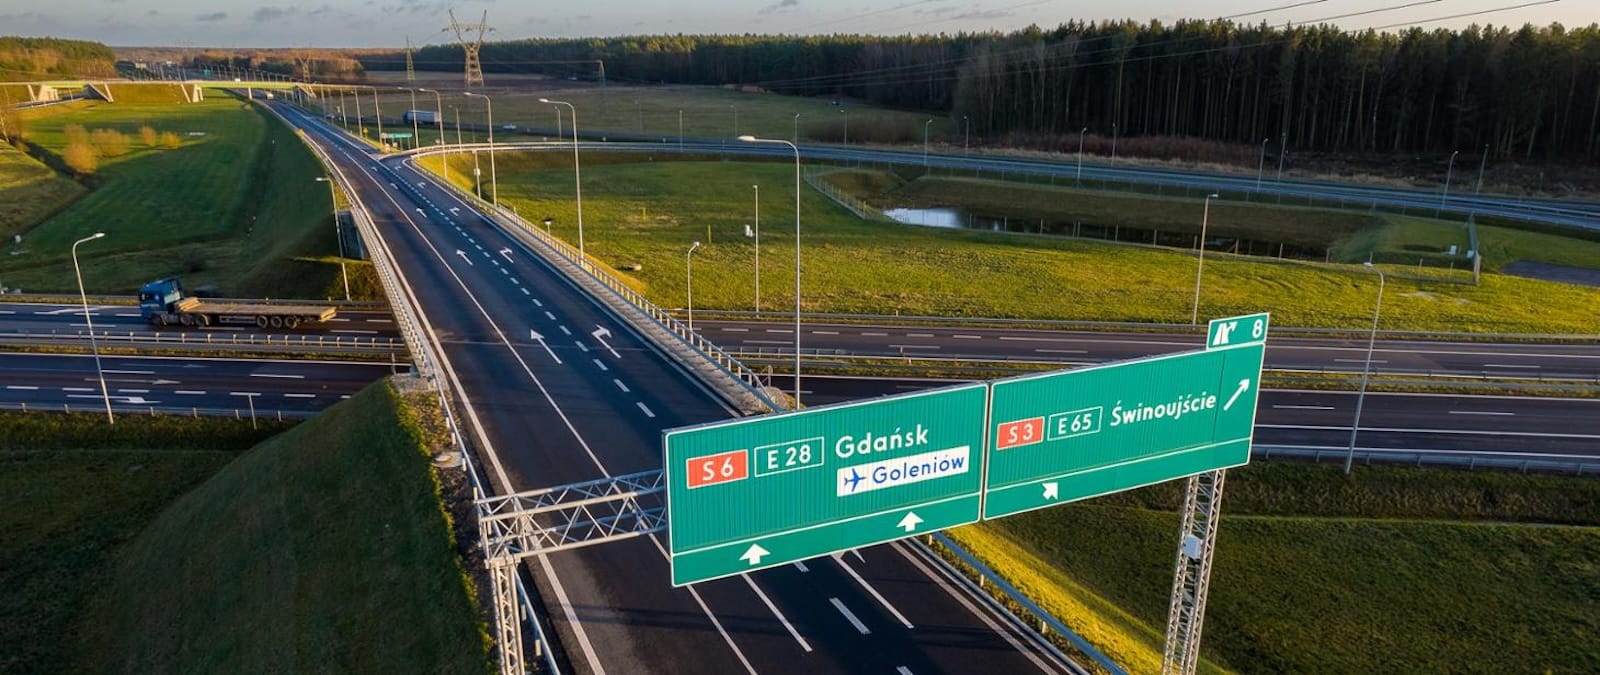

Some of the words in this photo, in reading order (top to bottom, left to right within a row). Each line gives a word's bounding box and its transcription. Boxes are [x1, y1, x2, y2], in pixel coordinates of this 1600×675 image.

[1252, 319, 1263, 338] 8
[1110, 391, 1217, 427] Świnoujście
[1007, 426, 1018, 443] S
[1022, 423, 1033, 441] 3
[1058, 417, 1067, 435] E
[1071, 413, 1092, 432] 65
[835, 424, 929, 458] Gdańsk
[767, 450, 779, 469] E
[785, 444, 811, 466] 28
[872, 453, 965, 484] Goleniów
[702, 460, 713, 481] S
[720, 458, 734, 478] 6
